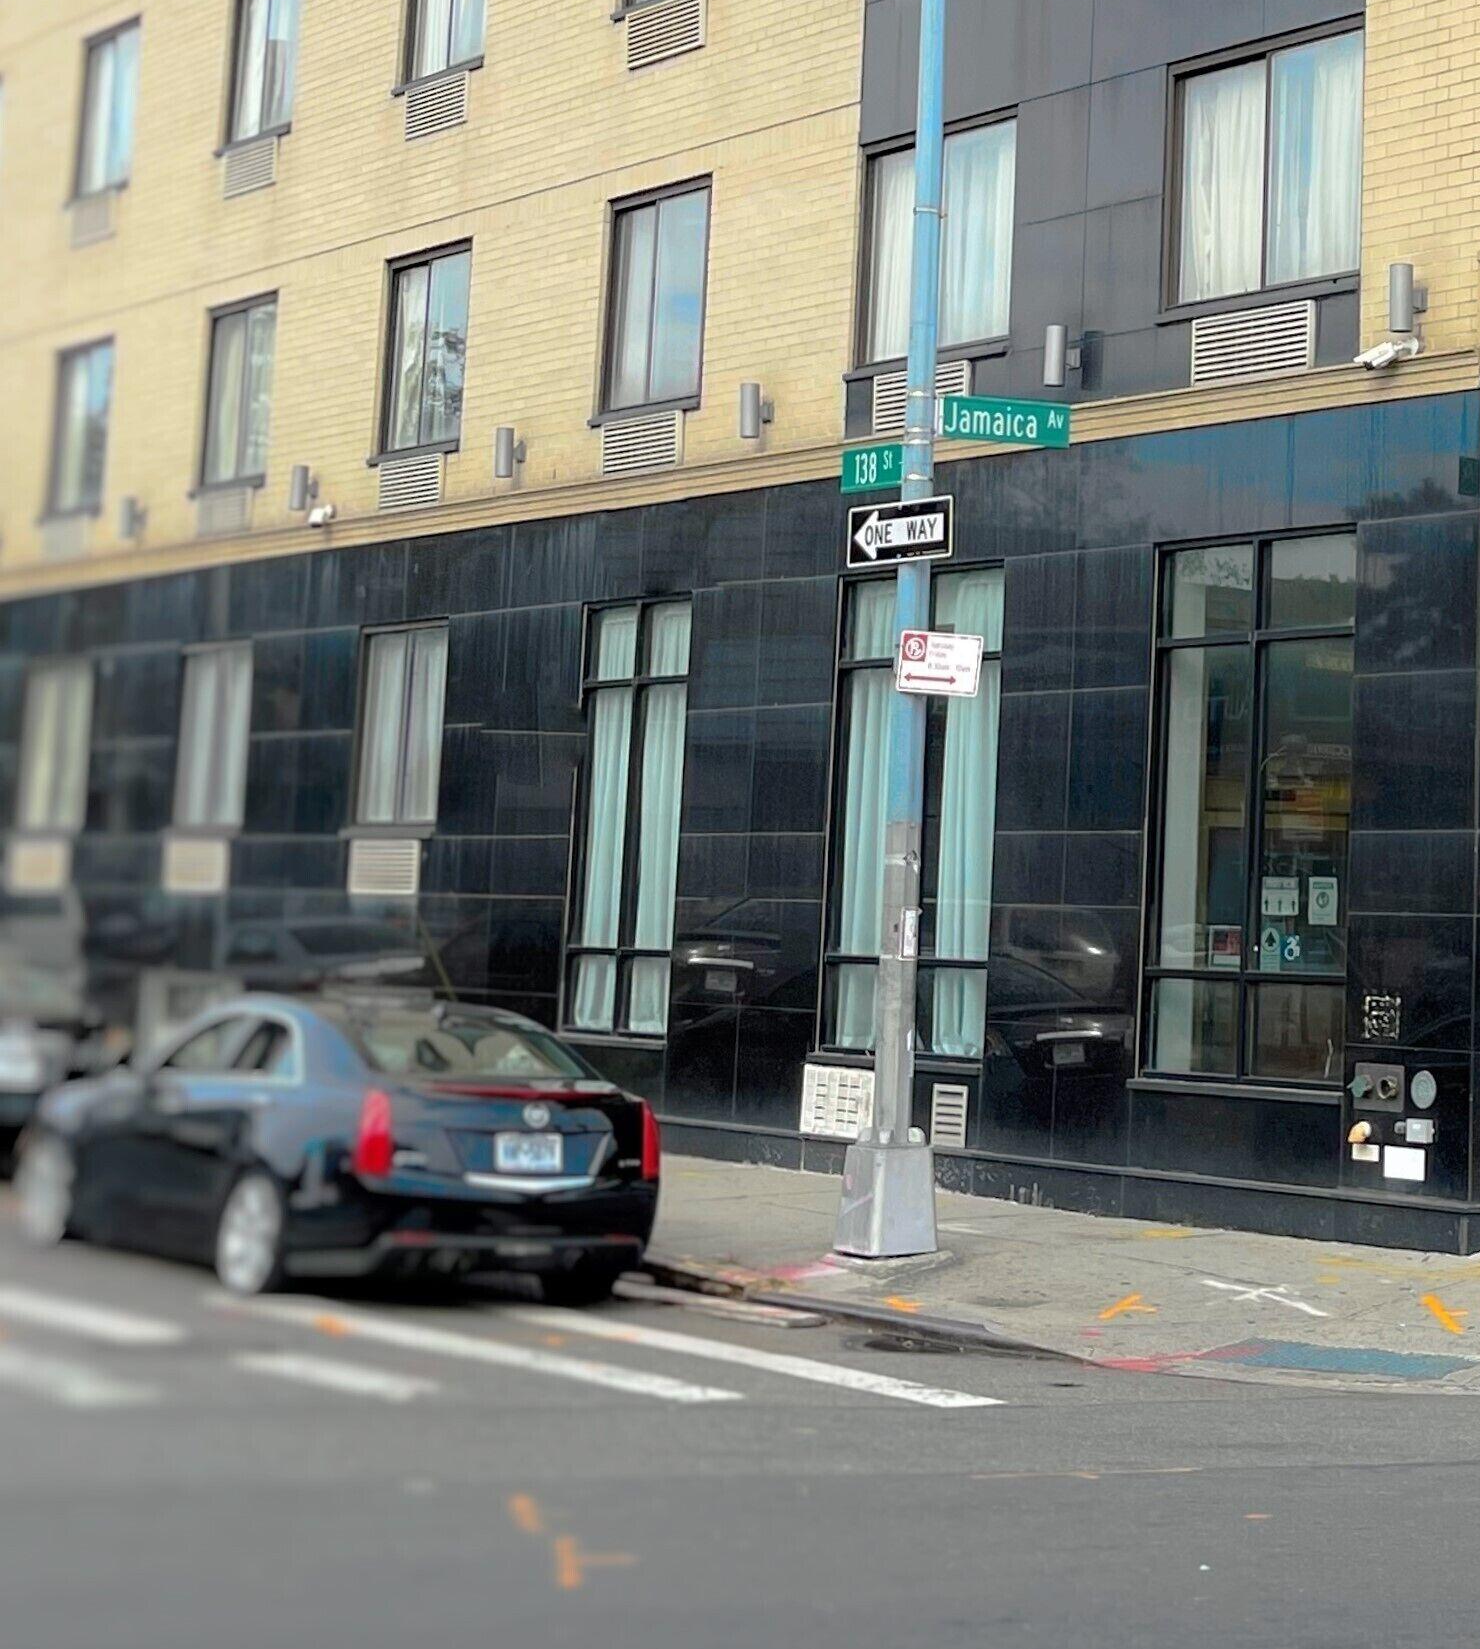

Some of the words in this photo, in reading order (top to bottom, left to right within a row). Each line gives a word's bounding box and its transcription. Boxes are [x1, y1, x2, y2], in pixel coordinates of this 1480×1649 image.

[945, 402, 1037, 438] Jamaica
[1047, 409, 1065, 431] Av
[855, 453, 877, 484] 138
[883, 450, 893, 471] St
[864, 524, 893, 546] ONE
[907, 516, 938, 540] WAY
